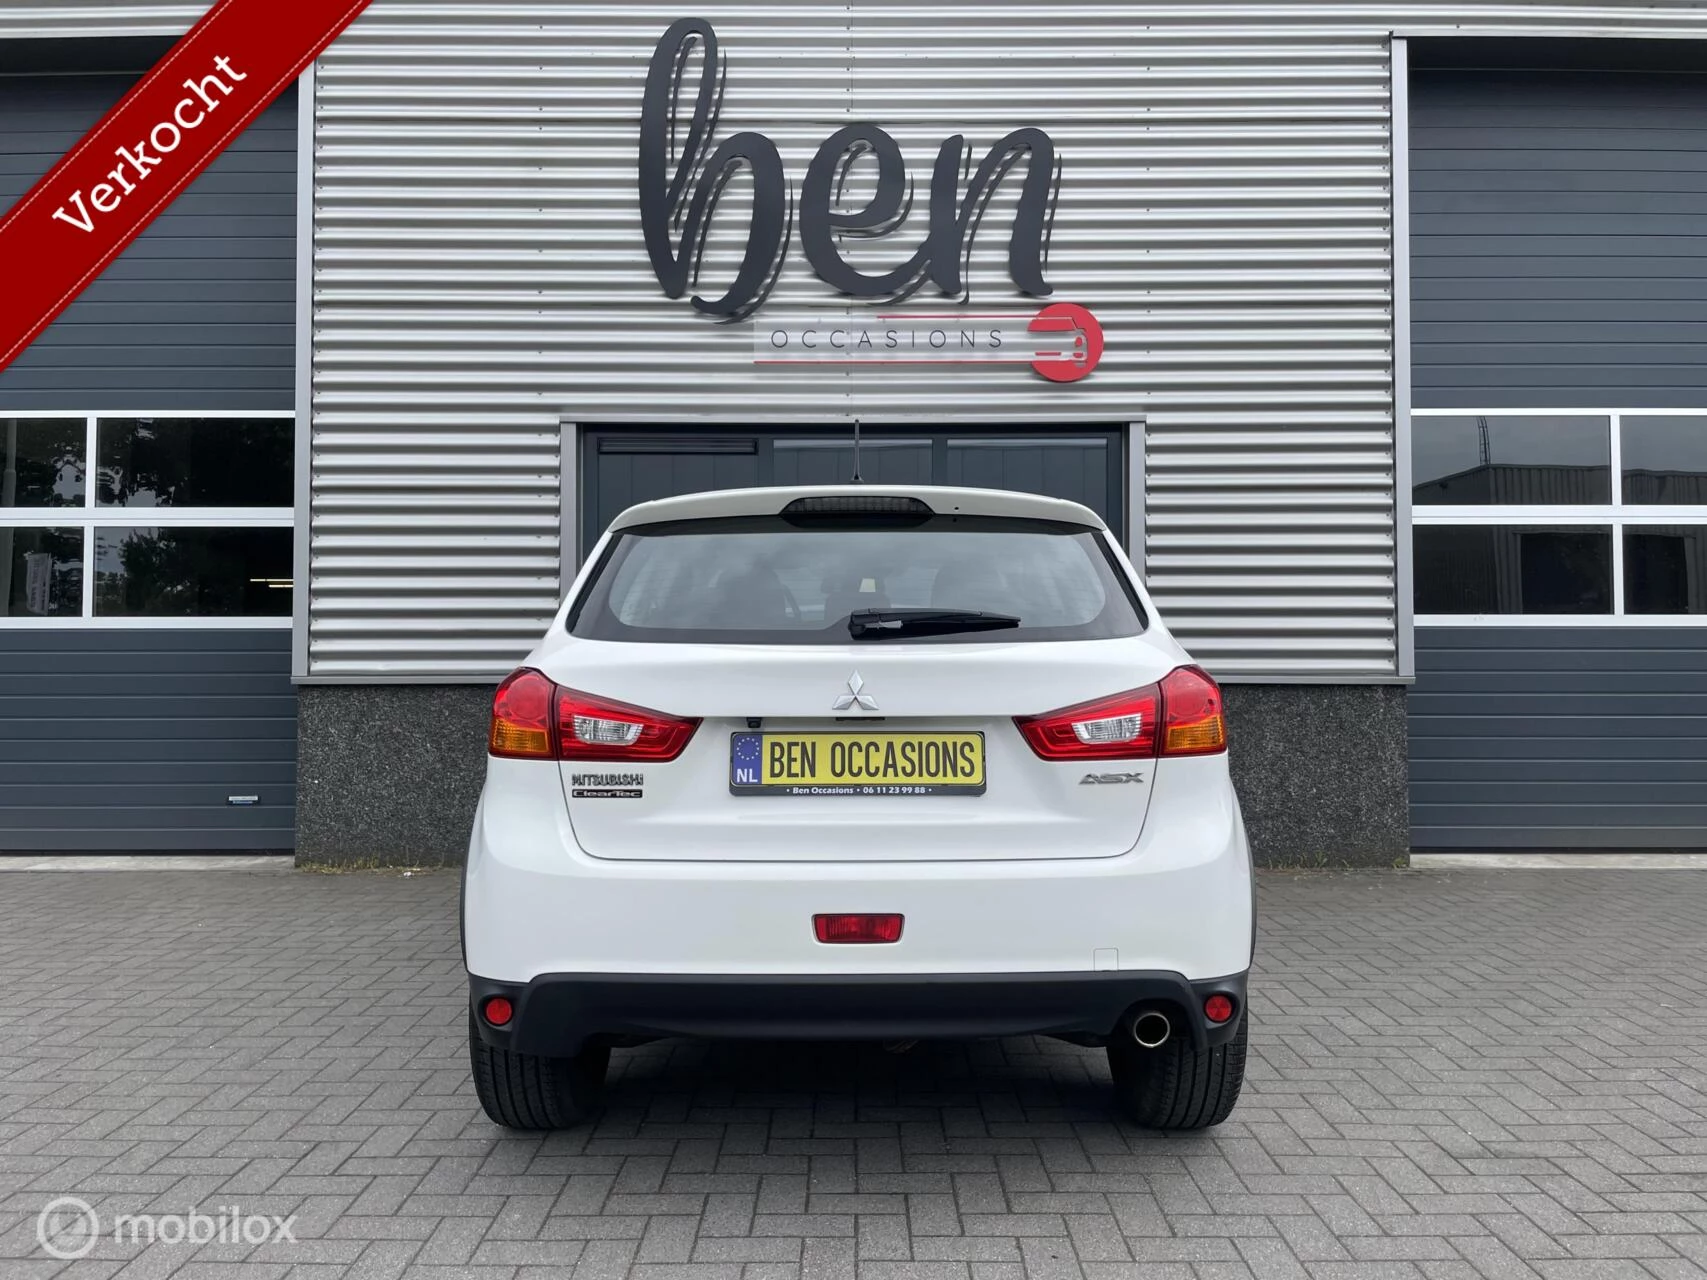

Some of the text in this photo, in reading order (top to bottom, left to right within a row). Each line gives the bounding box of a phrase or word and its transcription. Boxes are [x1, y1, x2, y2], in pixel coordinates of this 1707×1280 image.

[638, 17, 1057, 318] ben
[770, 329, 1002, 349] OCCASIONS
[769, 741, 975, 778] BEN OCCASIONS
[572, 774, 644, 786] MITSUBISHI
[736, 768, 758, 783] NL
[1079, 773, 1144, 785] ASX
[573, 790, 642, 798] ClearTec
[792, 786, 926, 794] Ben Occasions 06 11 23 99 88
